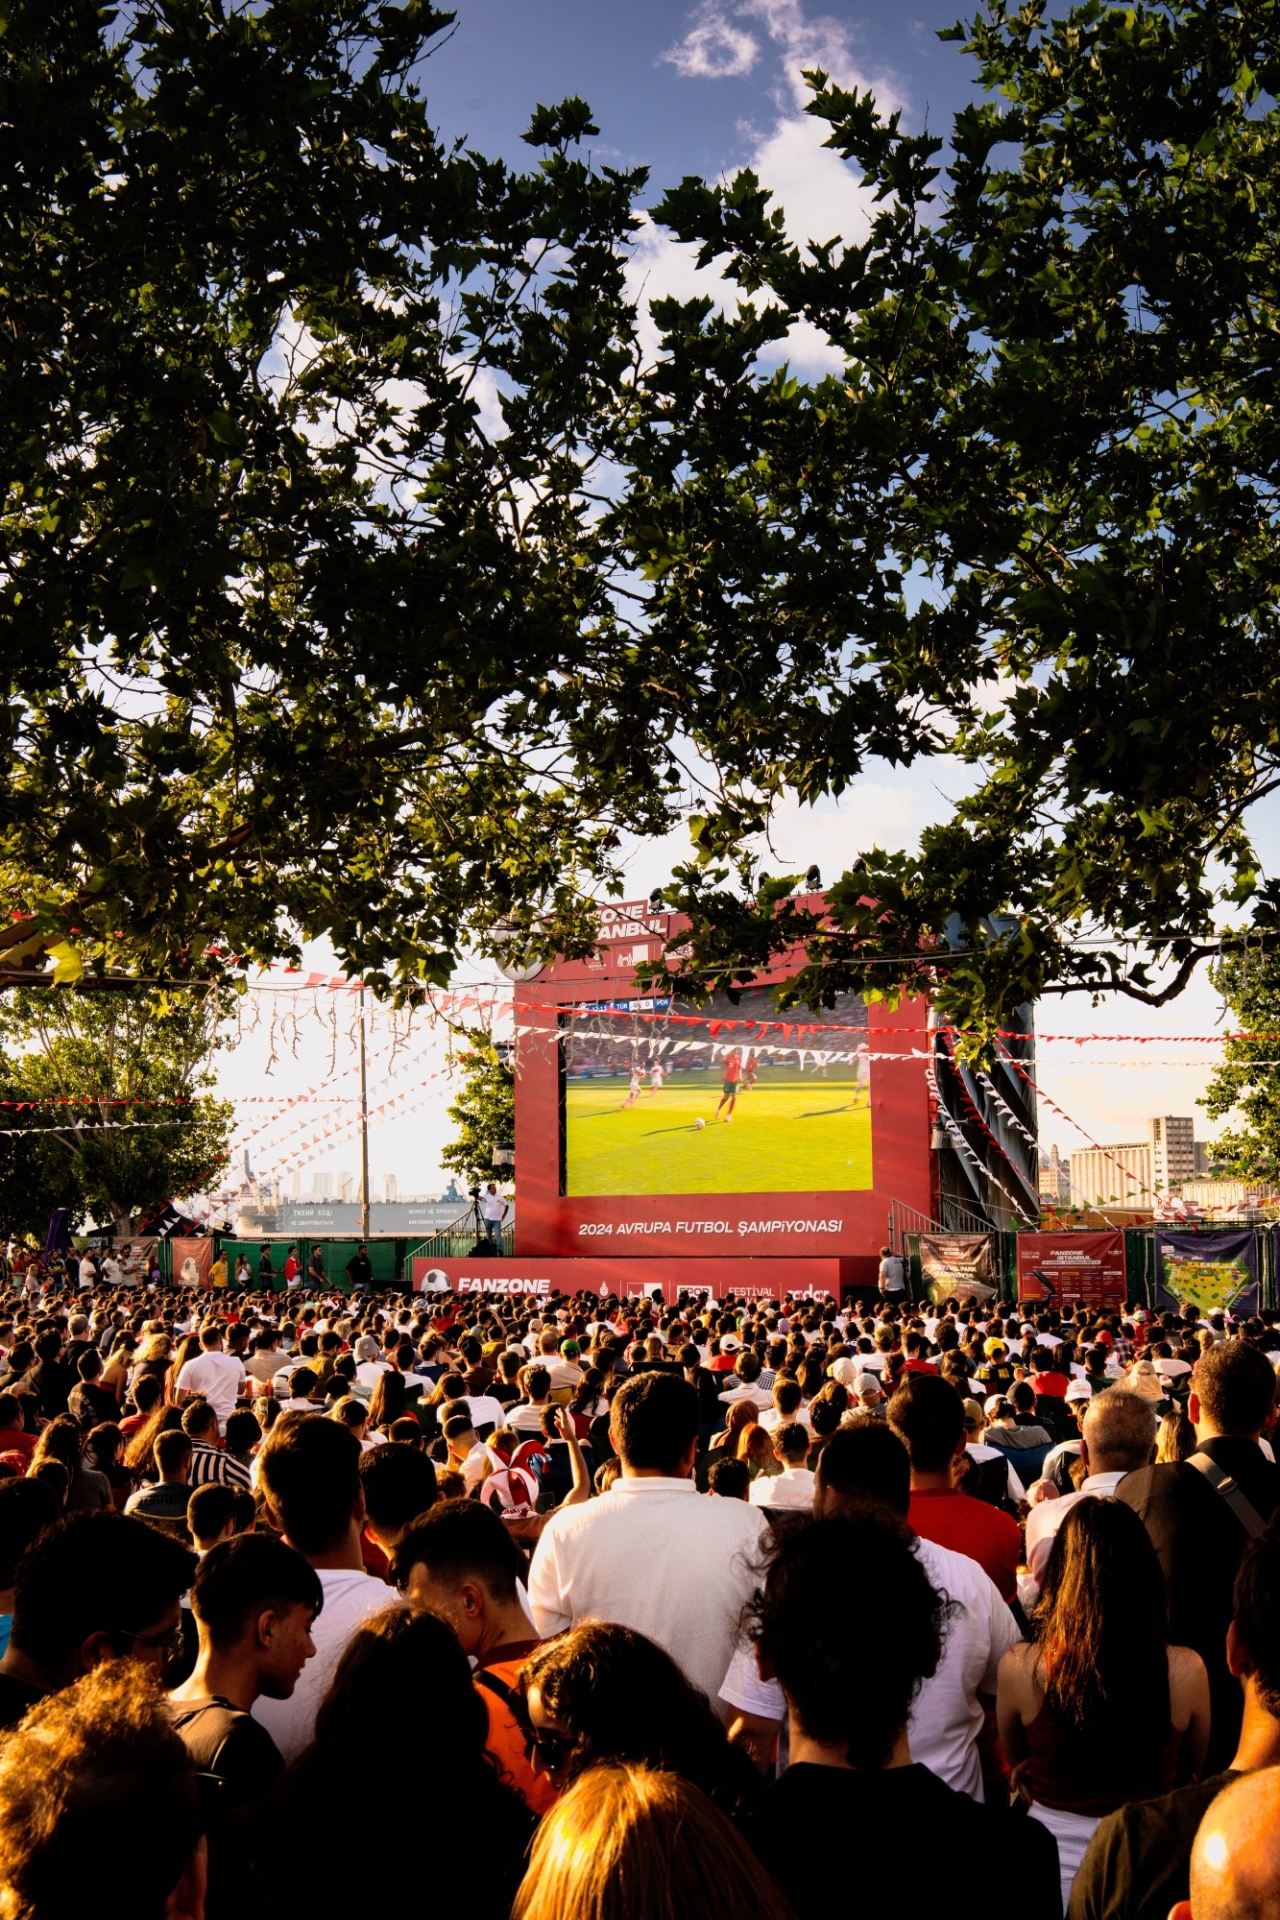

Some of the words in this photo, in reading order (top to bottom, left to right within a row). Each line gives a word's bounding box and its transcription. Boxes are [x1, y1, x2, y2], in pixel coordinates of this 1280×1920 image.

[595, 919, 667, 940] ANBUL
[616, 1002, 628, 1010] TÜR
[578, 1223, 613, 1236] 2024
[616, 1222, 672, 1235] AVRUPA
[675, 1221, 734, 1234] FUTBOL
[457, 1277, 550, 1294] FANZONE
